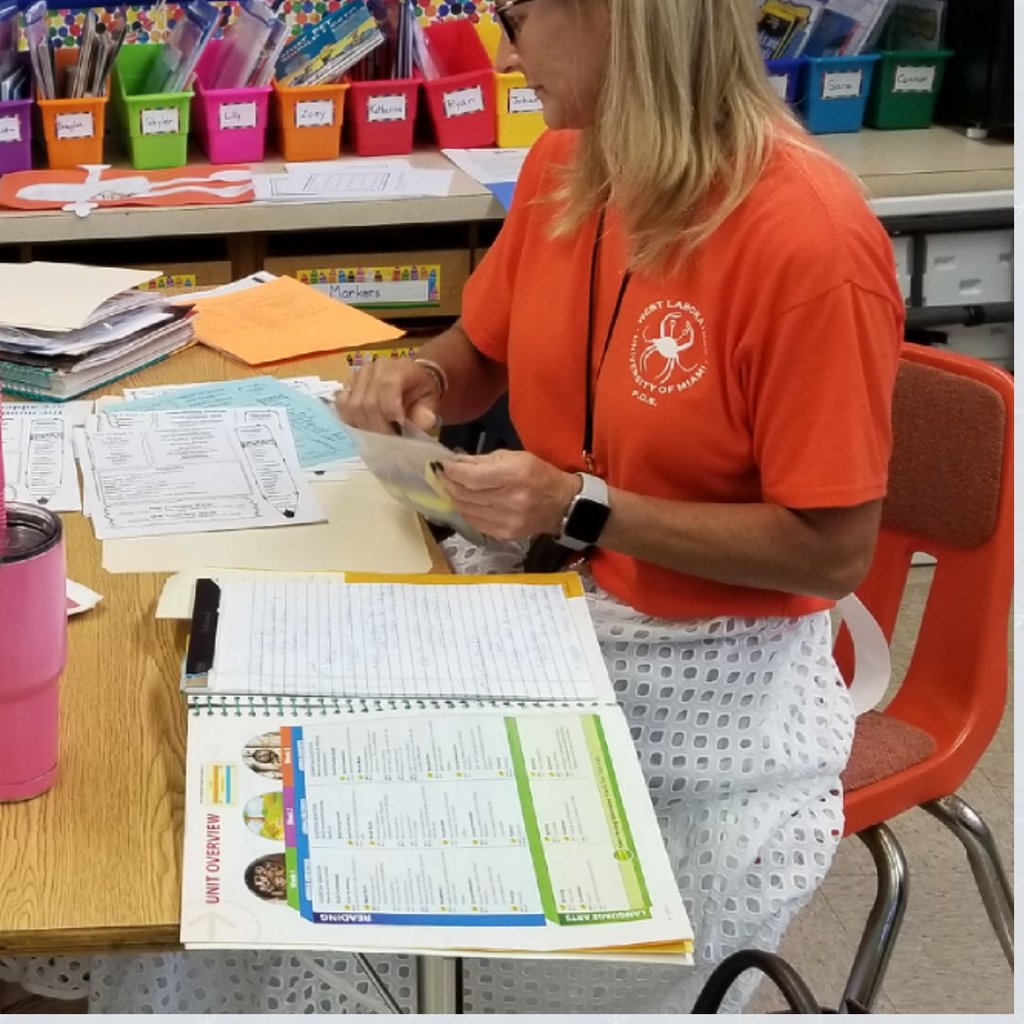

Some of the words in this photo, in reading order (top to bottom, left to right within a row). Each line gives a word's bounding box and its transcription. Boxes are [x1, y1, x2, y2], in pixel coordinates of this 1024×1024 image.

[828, 79, 853, 91] Sara
[447, 96, 476, 109] Ryan
[300, 109, 326, 122] Zoey
[329, 285, 381, 299] Markers
[658, 385, 674, 394] OF
[677, 365, 707, 392] MIAMI
[206, 813, 220, 872] OVERVIEW
[205, 875, 220, 904] UNIT
[320, 914, 372, 923] READING
